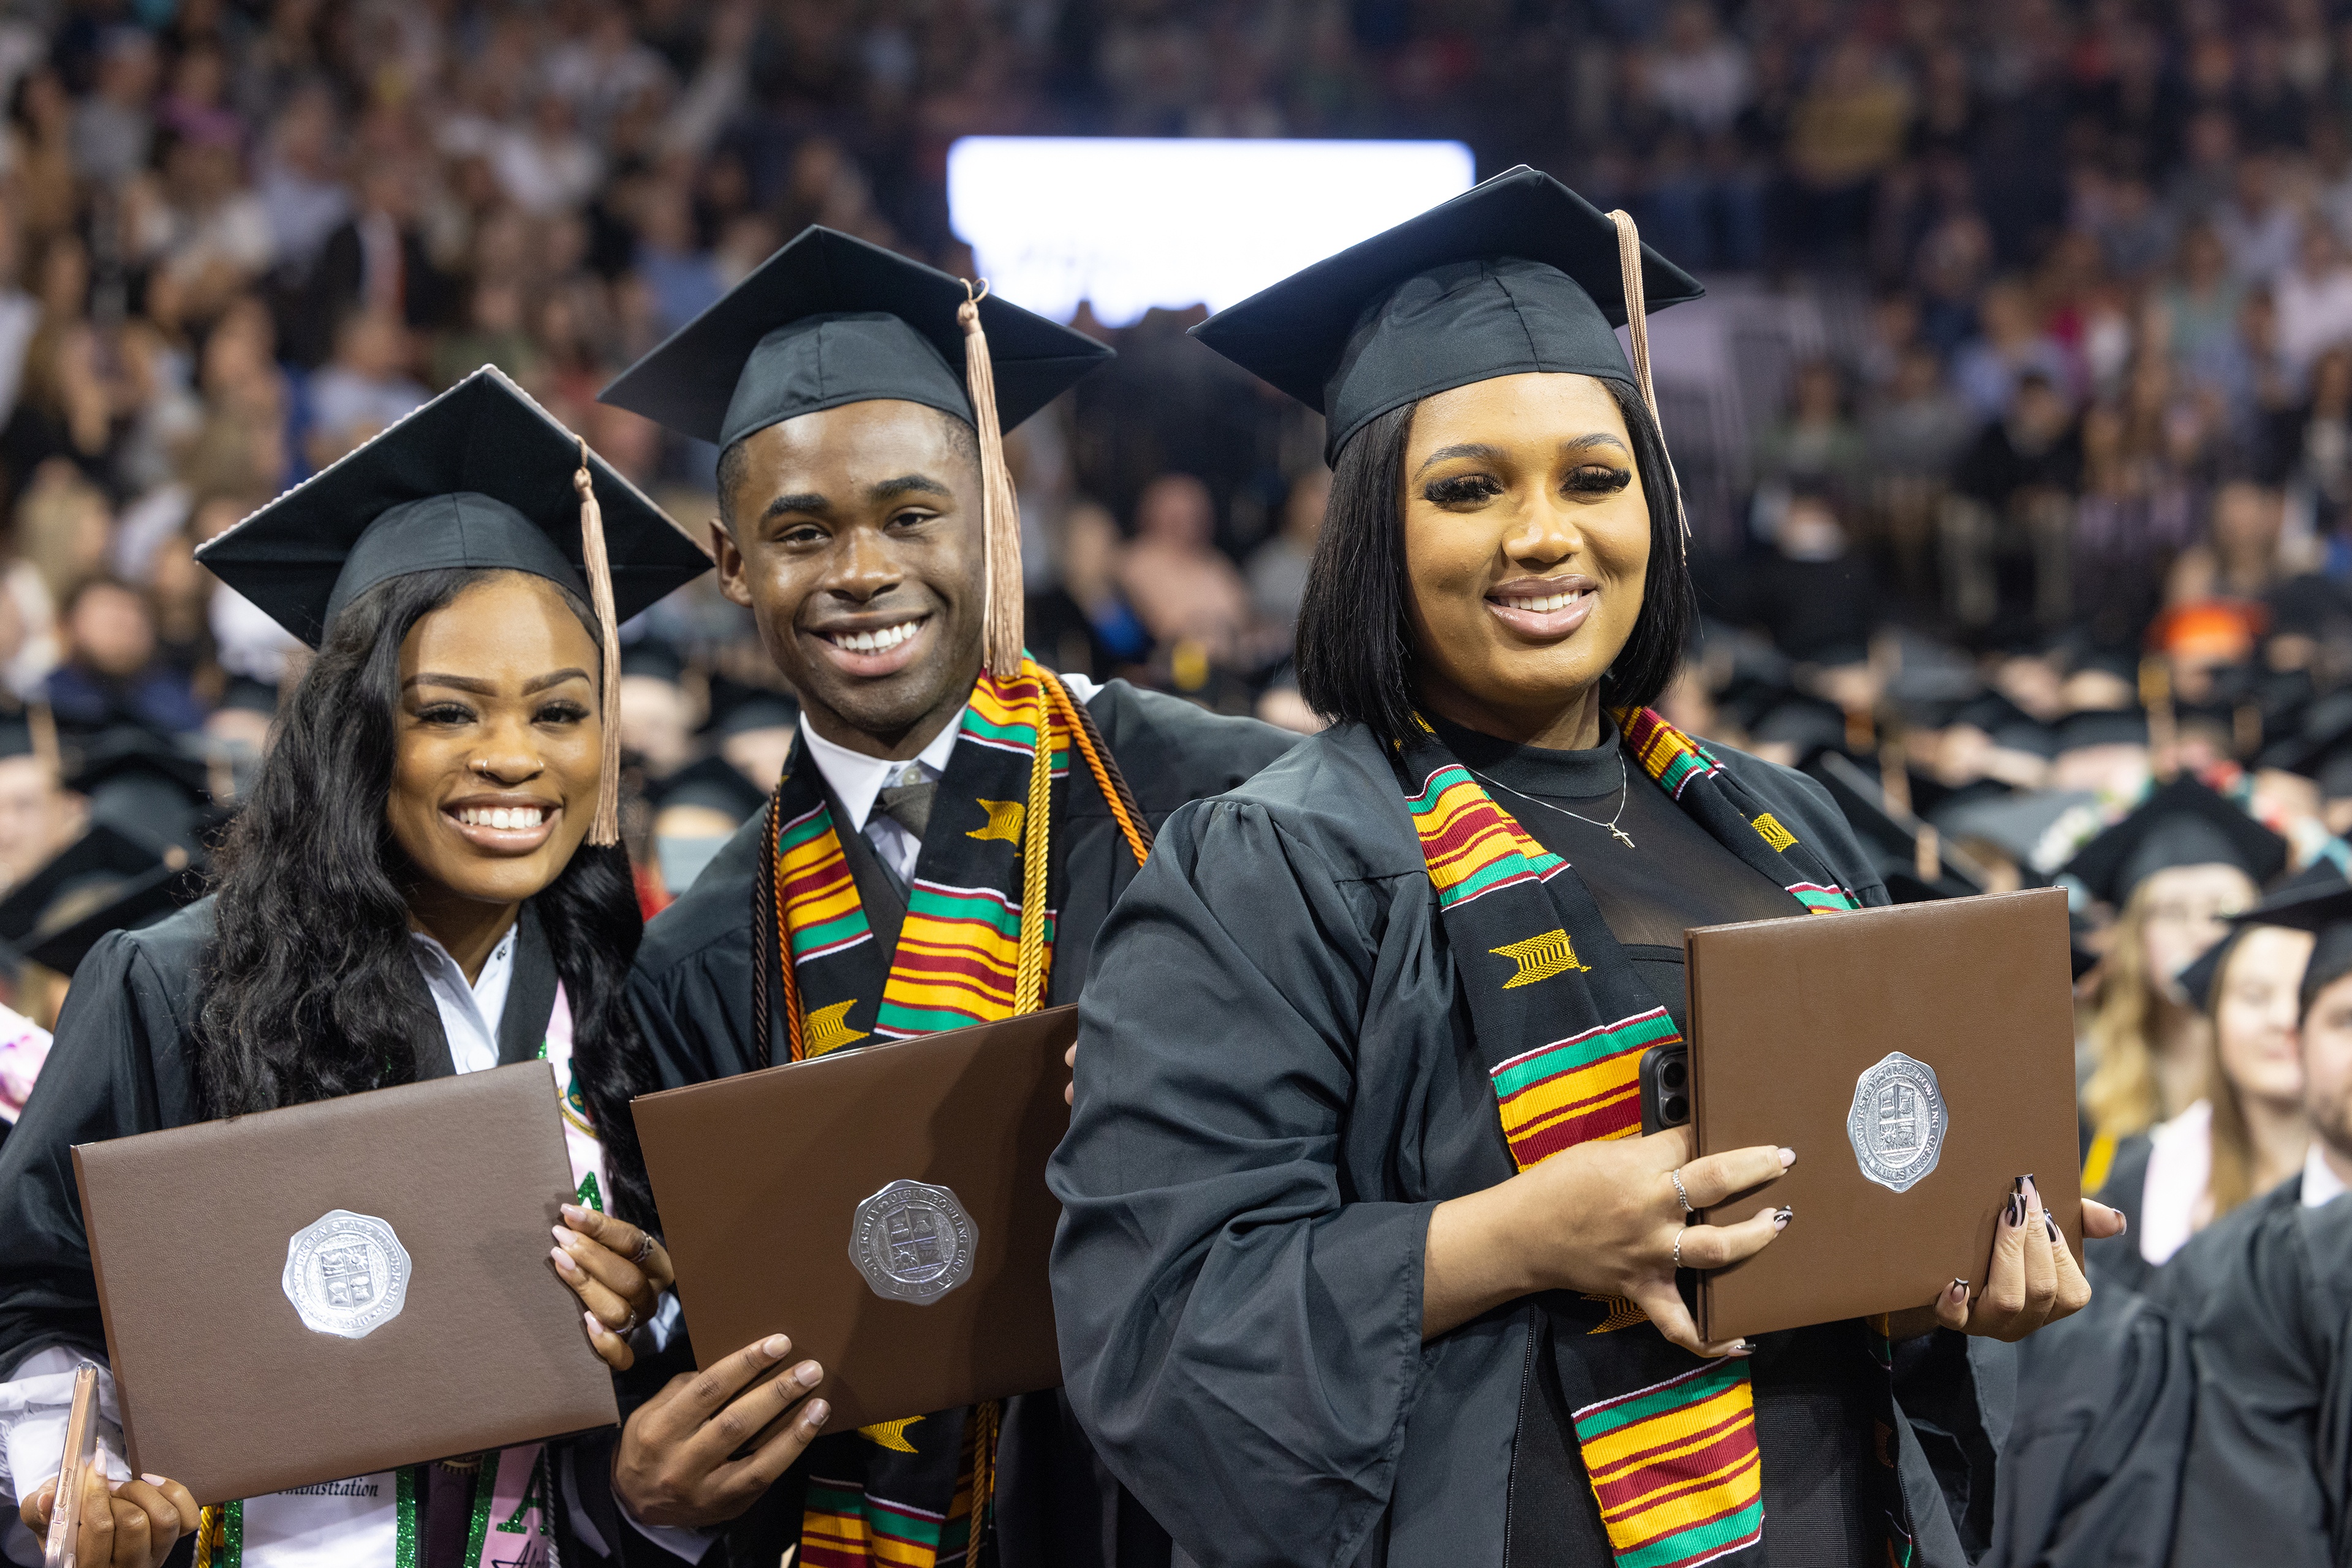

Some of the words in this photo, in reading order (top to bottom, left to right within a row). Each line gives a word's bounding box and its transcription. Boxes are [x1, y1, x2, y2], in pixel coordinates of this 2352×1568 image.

[1916, 1072, 1939, 1129] BOWLING
[1873, 1164, 1905, 1180] STATE
[1908, 1135, 1937, 1175] GREEN
[929, 1193, 969, 1244] BOWLING
[295, 1225, 328, 1267] GREEN
[331, 1219, 374, 1235] STATE
[860, 1205, 888, 1284] UNIVERSITY
[891, 1281, 932, 1295] STATE
[936, 1250, 967, 1289] GREEN
